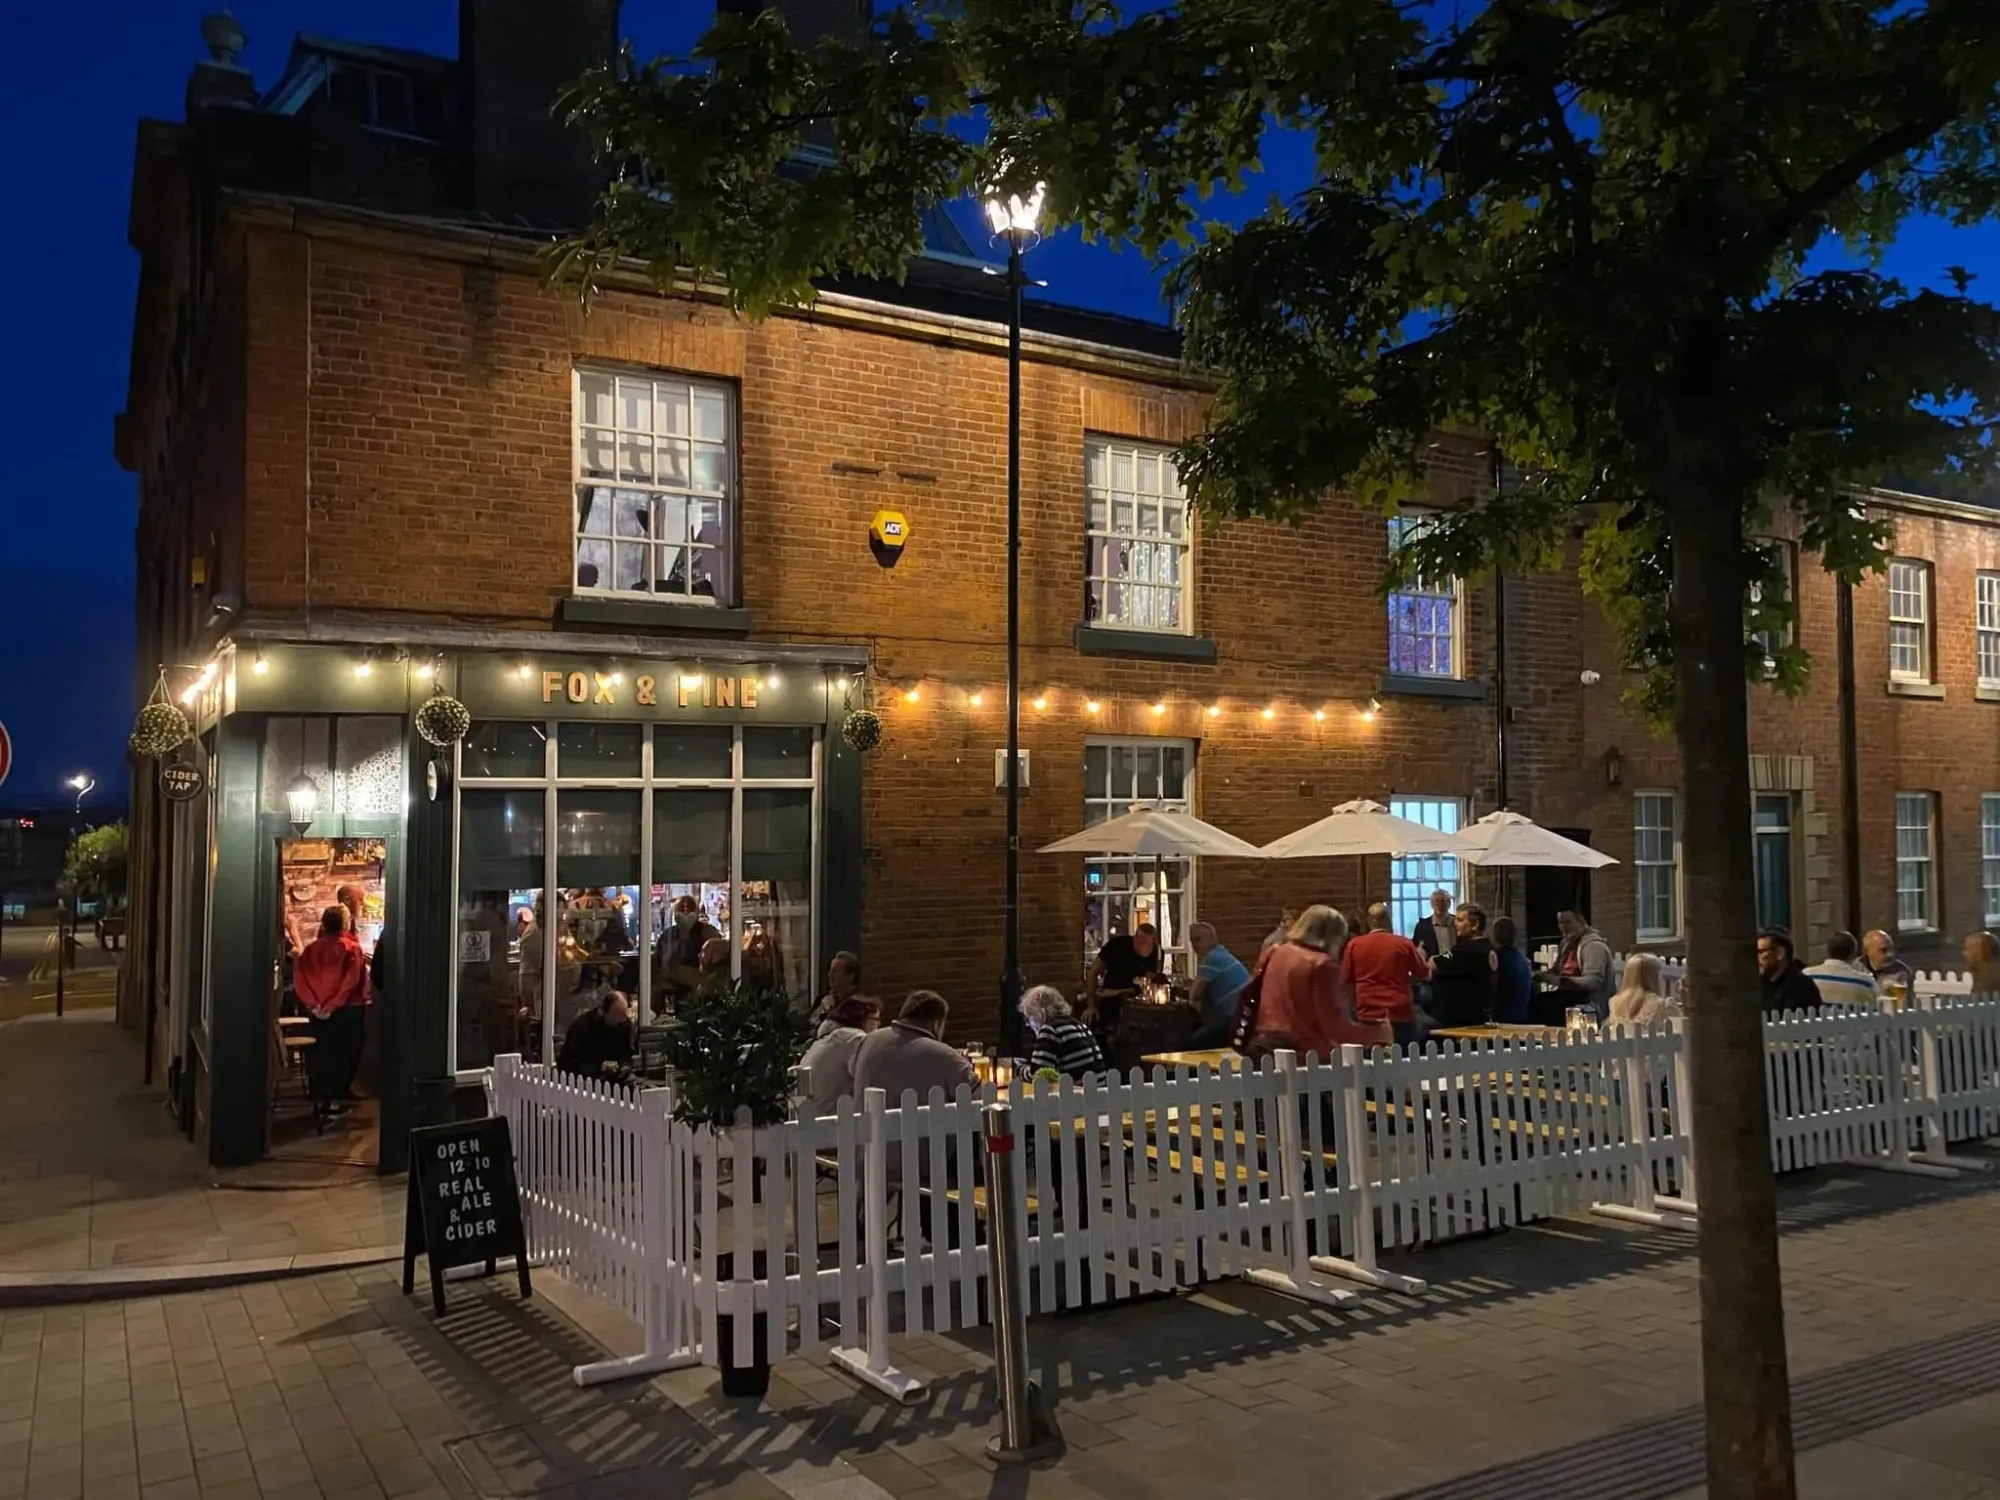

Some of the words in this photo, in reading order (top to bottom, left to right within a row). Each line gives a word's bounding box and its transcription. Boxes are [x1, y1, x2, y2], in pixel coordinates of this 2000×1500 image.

[542, 670, 615, 704] FOX
[636, 675, 657, 706] &
[164, 770, 199, 781] CIDER
[169, 780, 191, 791] TAP
[437, 1138, 481, 1159] OPEN
[449, 1159, 466, 1175] 12
[475, 1156, 491, 1171] 10
[438, 1176, 485, 1198] REAL
[461, 1192, 493, 1212] ALE
[449, 1208, 461, 1224] &
[445, 1219, 498, 1241] CIDER
